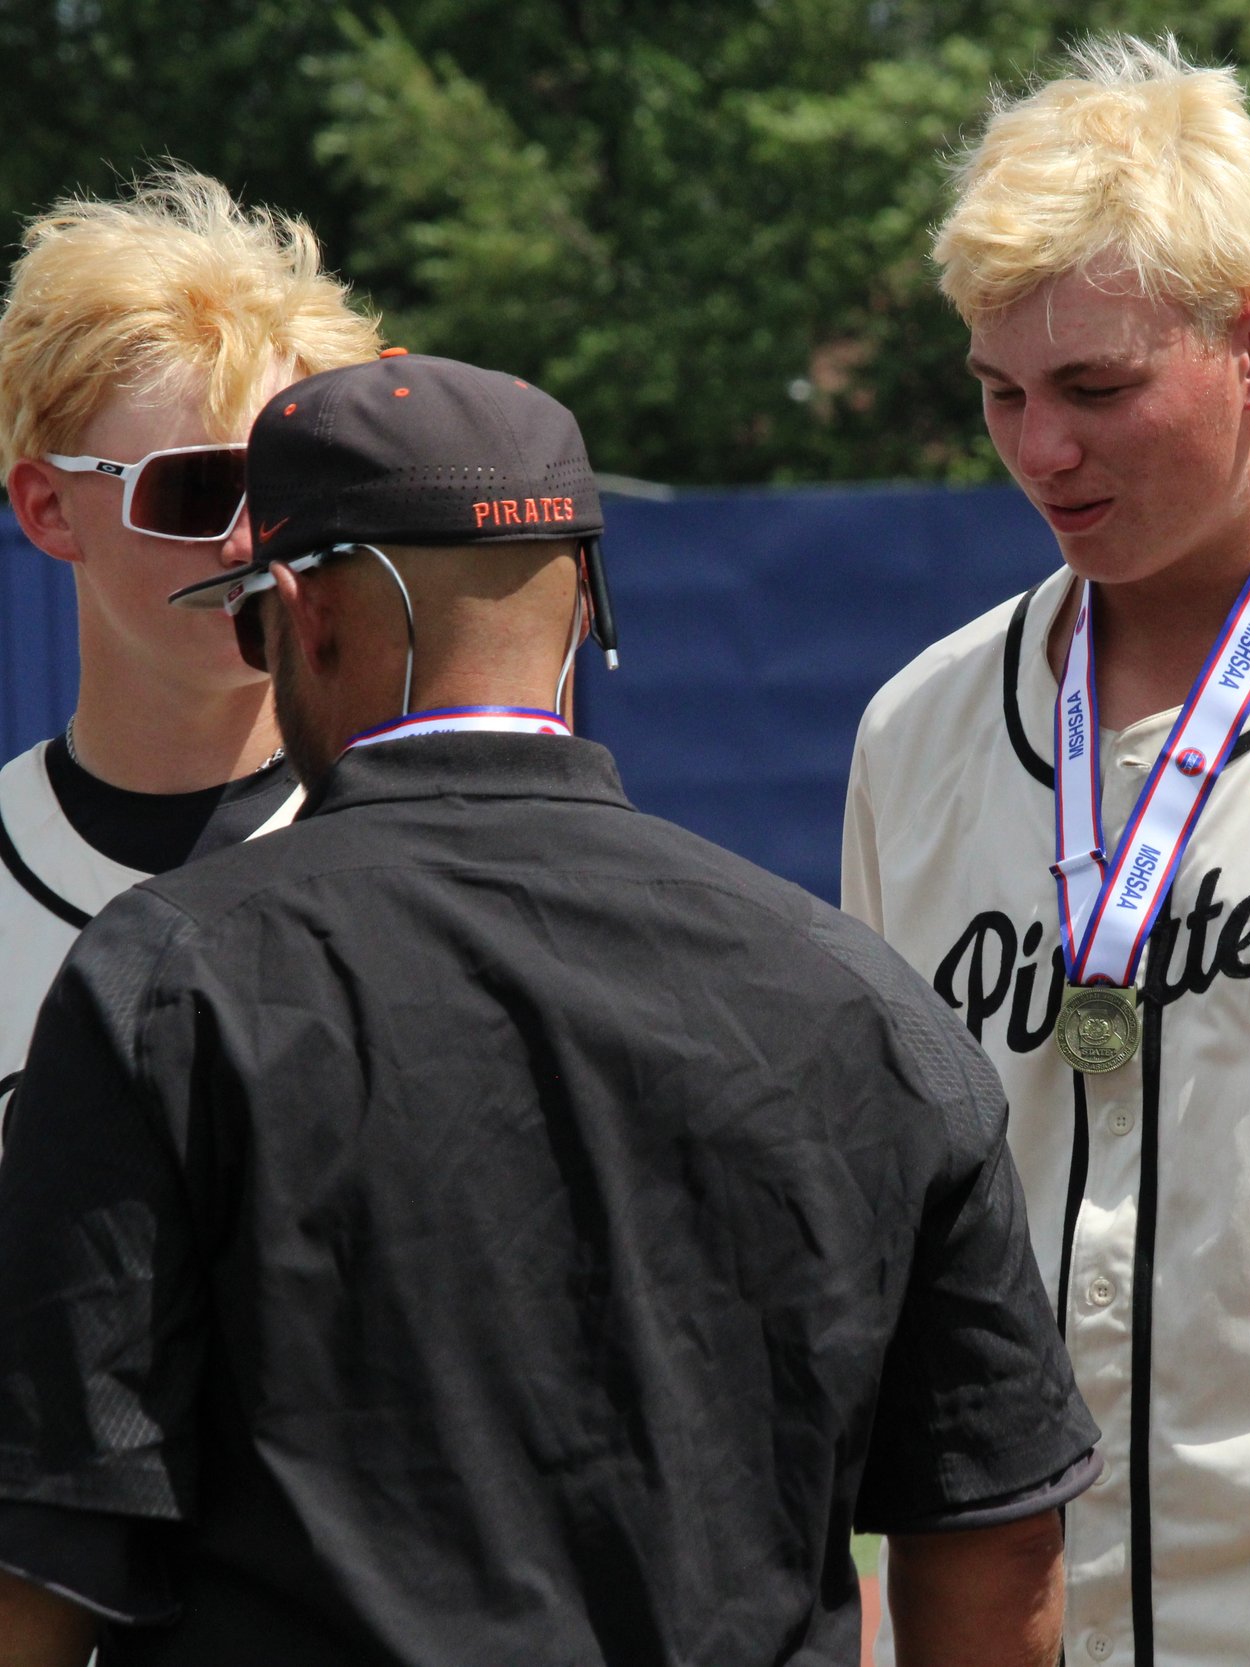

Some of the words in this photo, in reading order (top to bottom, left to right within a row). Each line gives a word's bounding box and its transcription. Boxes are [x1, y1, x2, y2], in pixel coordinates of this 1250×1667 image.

[473, 498, 574, 528] PIRATES
[1067, 689, 1084, 760] MSHSAA
[1116, 843, 1161, 911] MSHSAA
